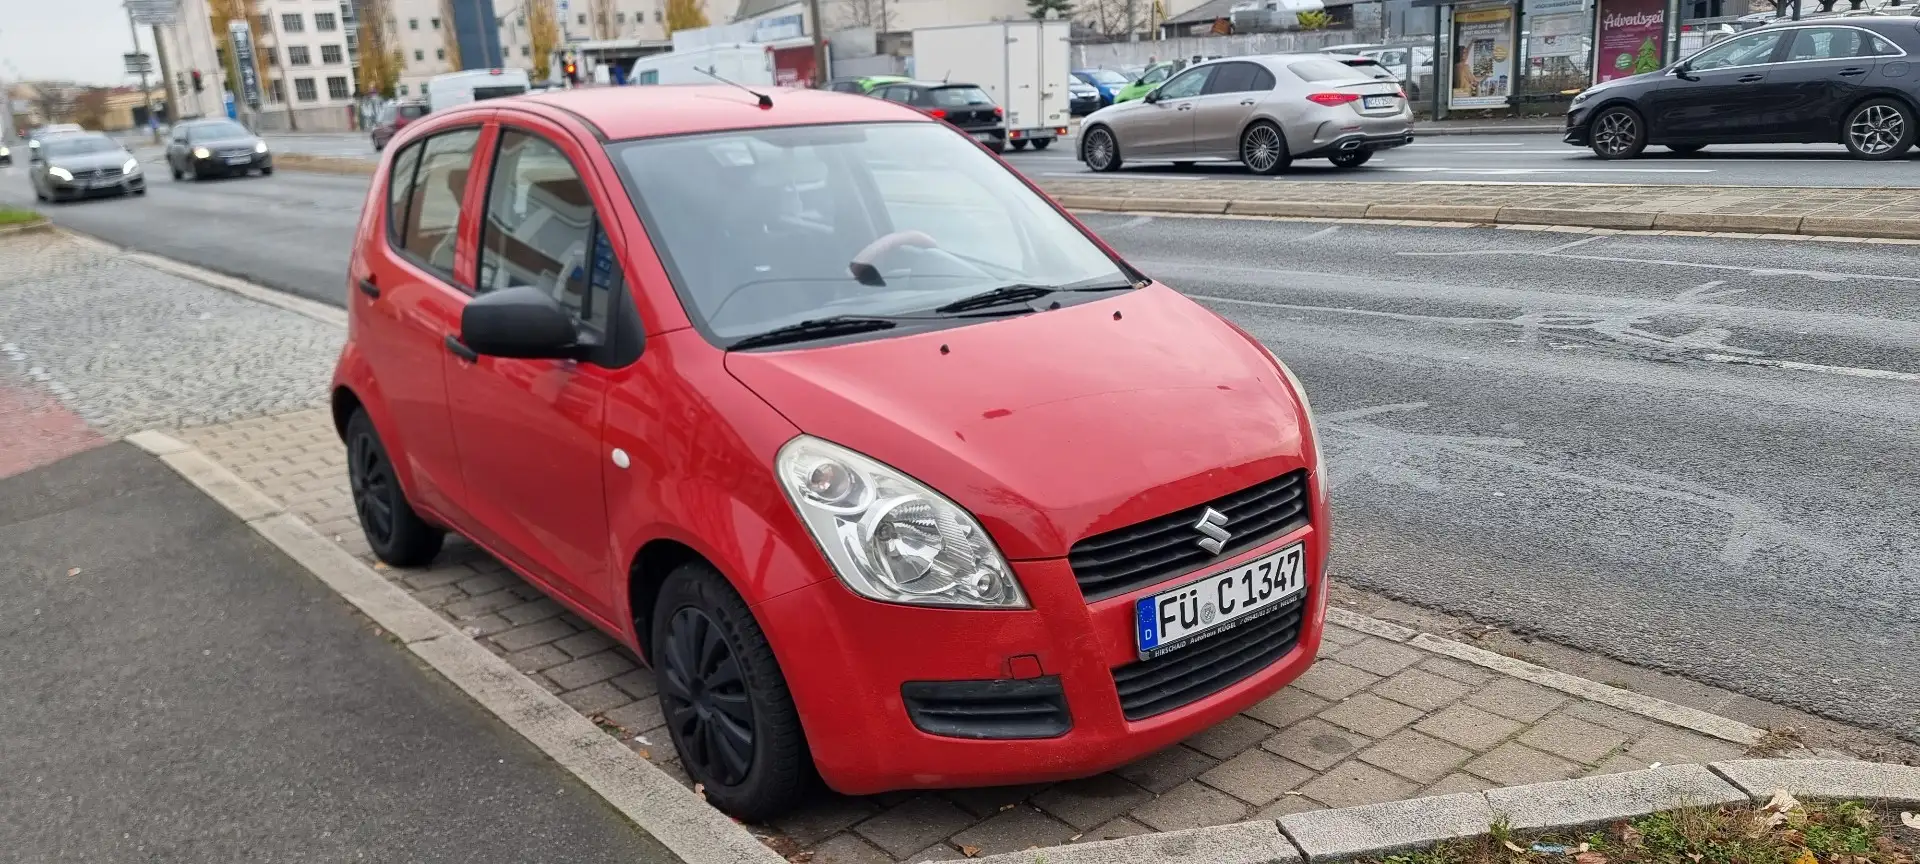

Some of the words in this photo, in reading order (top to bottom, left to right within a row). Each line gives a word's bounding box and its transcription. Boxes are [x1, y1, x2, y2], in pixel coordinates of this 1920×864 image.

[1604, 10, 1664, 30] Adventszeit
[1159, 589, 1198, 638] FÜ
[1218, 577, 1235, 615] C
[1242, 550, 1300, 608] 1347
[1145, 629, 1152, 640] D
[1155, 640, 1187, 658] HIRSCHAID
[1190, 630, 1217, 645] Autohaus
